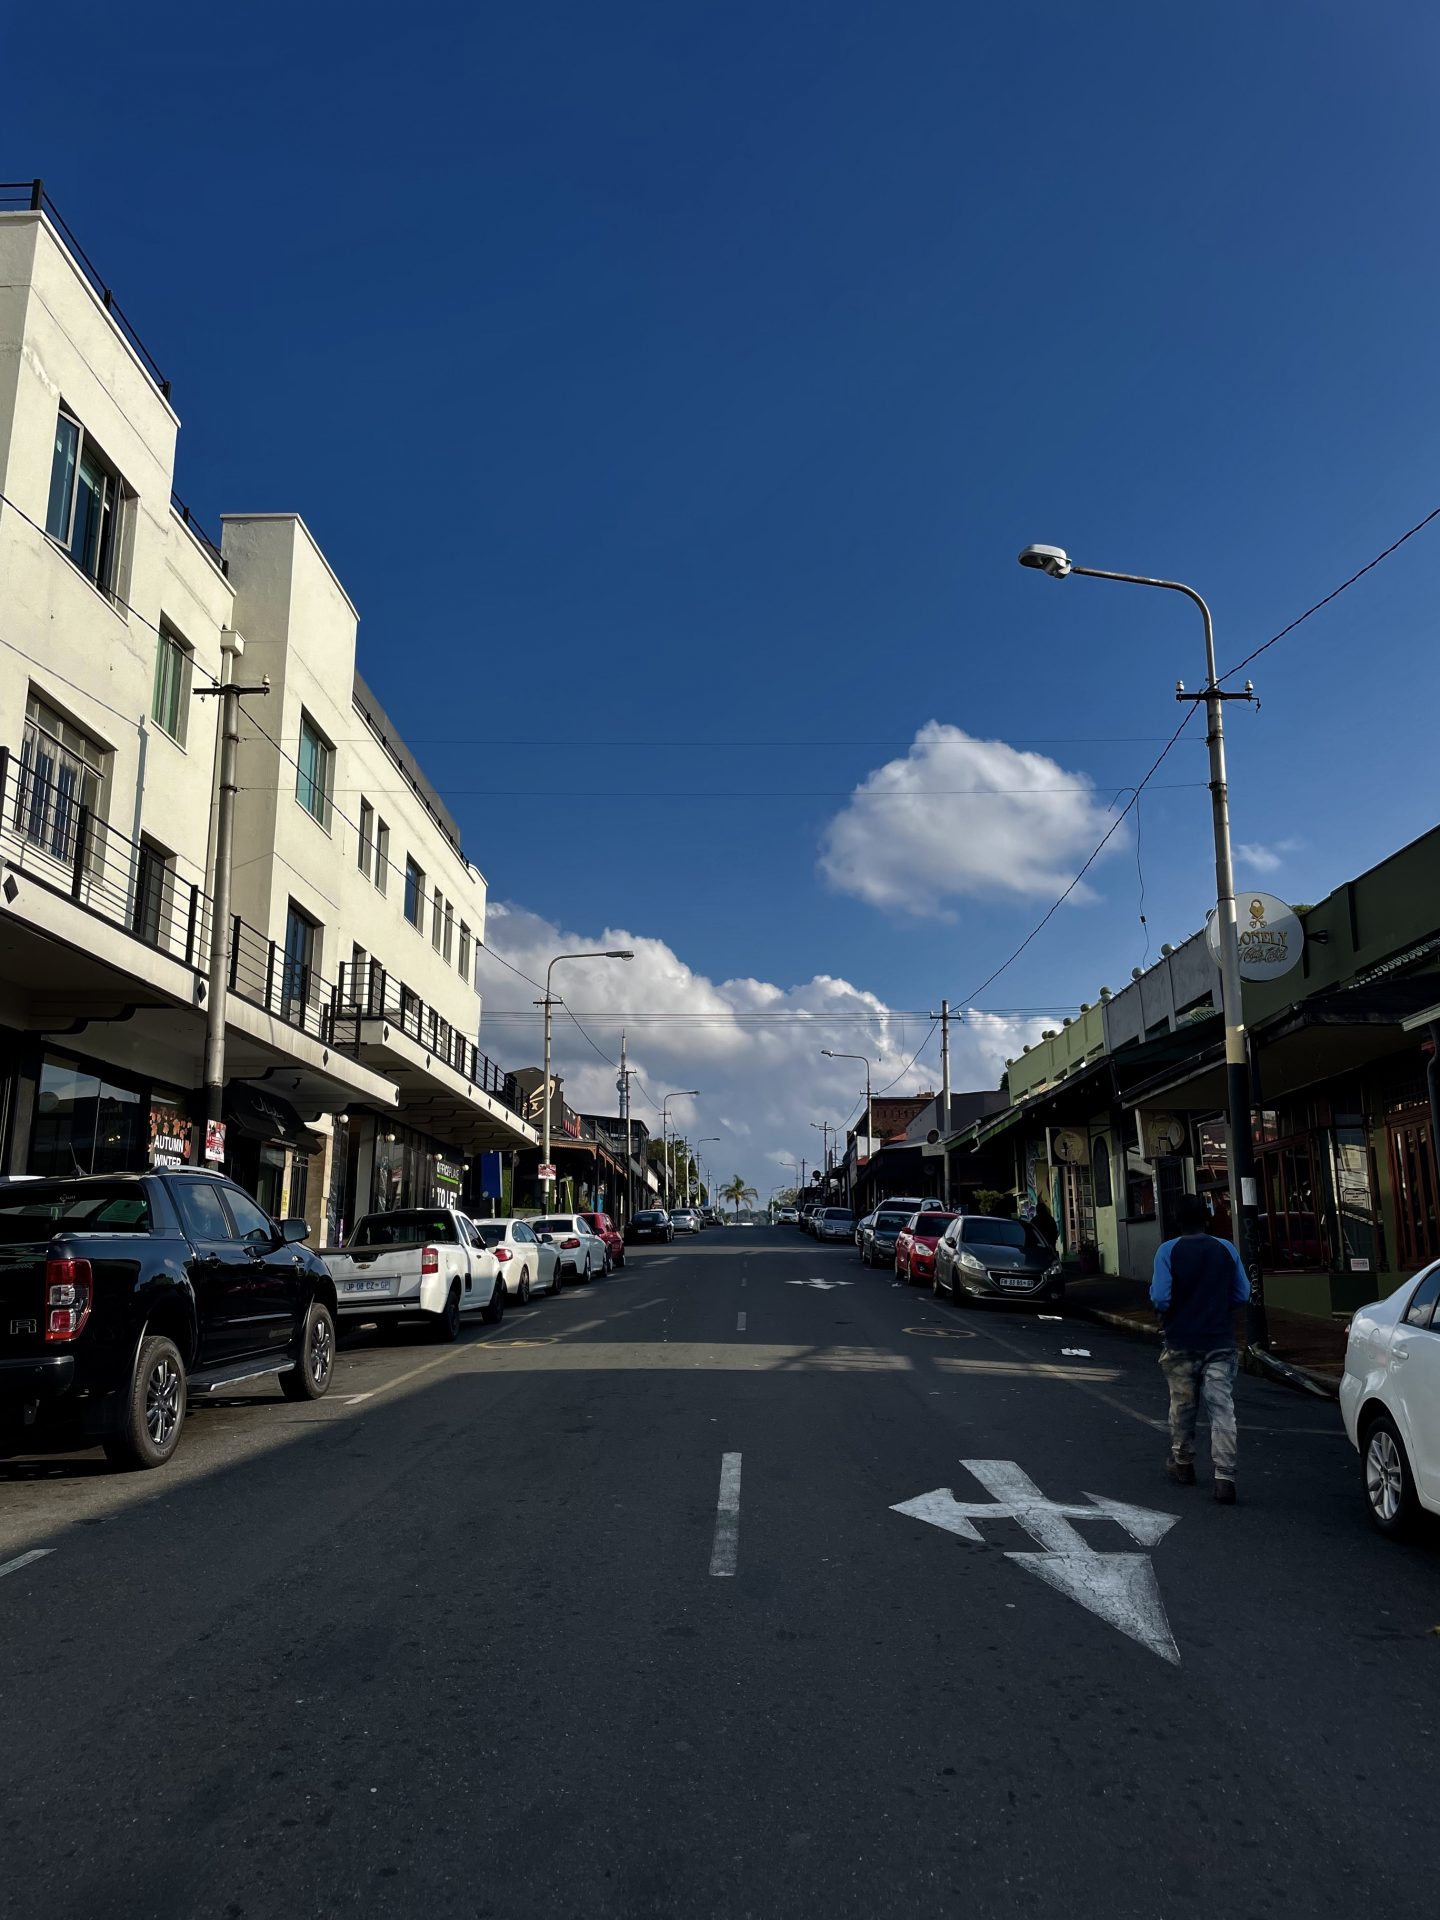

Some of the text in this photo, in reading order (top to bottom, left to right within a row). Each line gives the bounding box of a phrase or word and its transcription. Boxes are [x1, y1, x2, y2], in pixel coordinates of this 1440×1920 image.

[154, 1134, 184, 1153] AUTUMN
[437, 1187, 458, 1210] TO LET
